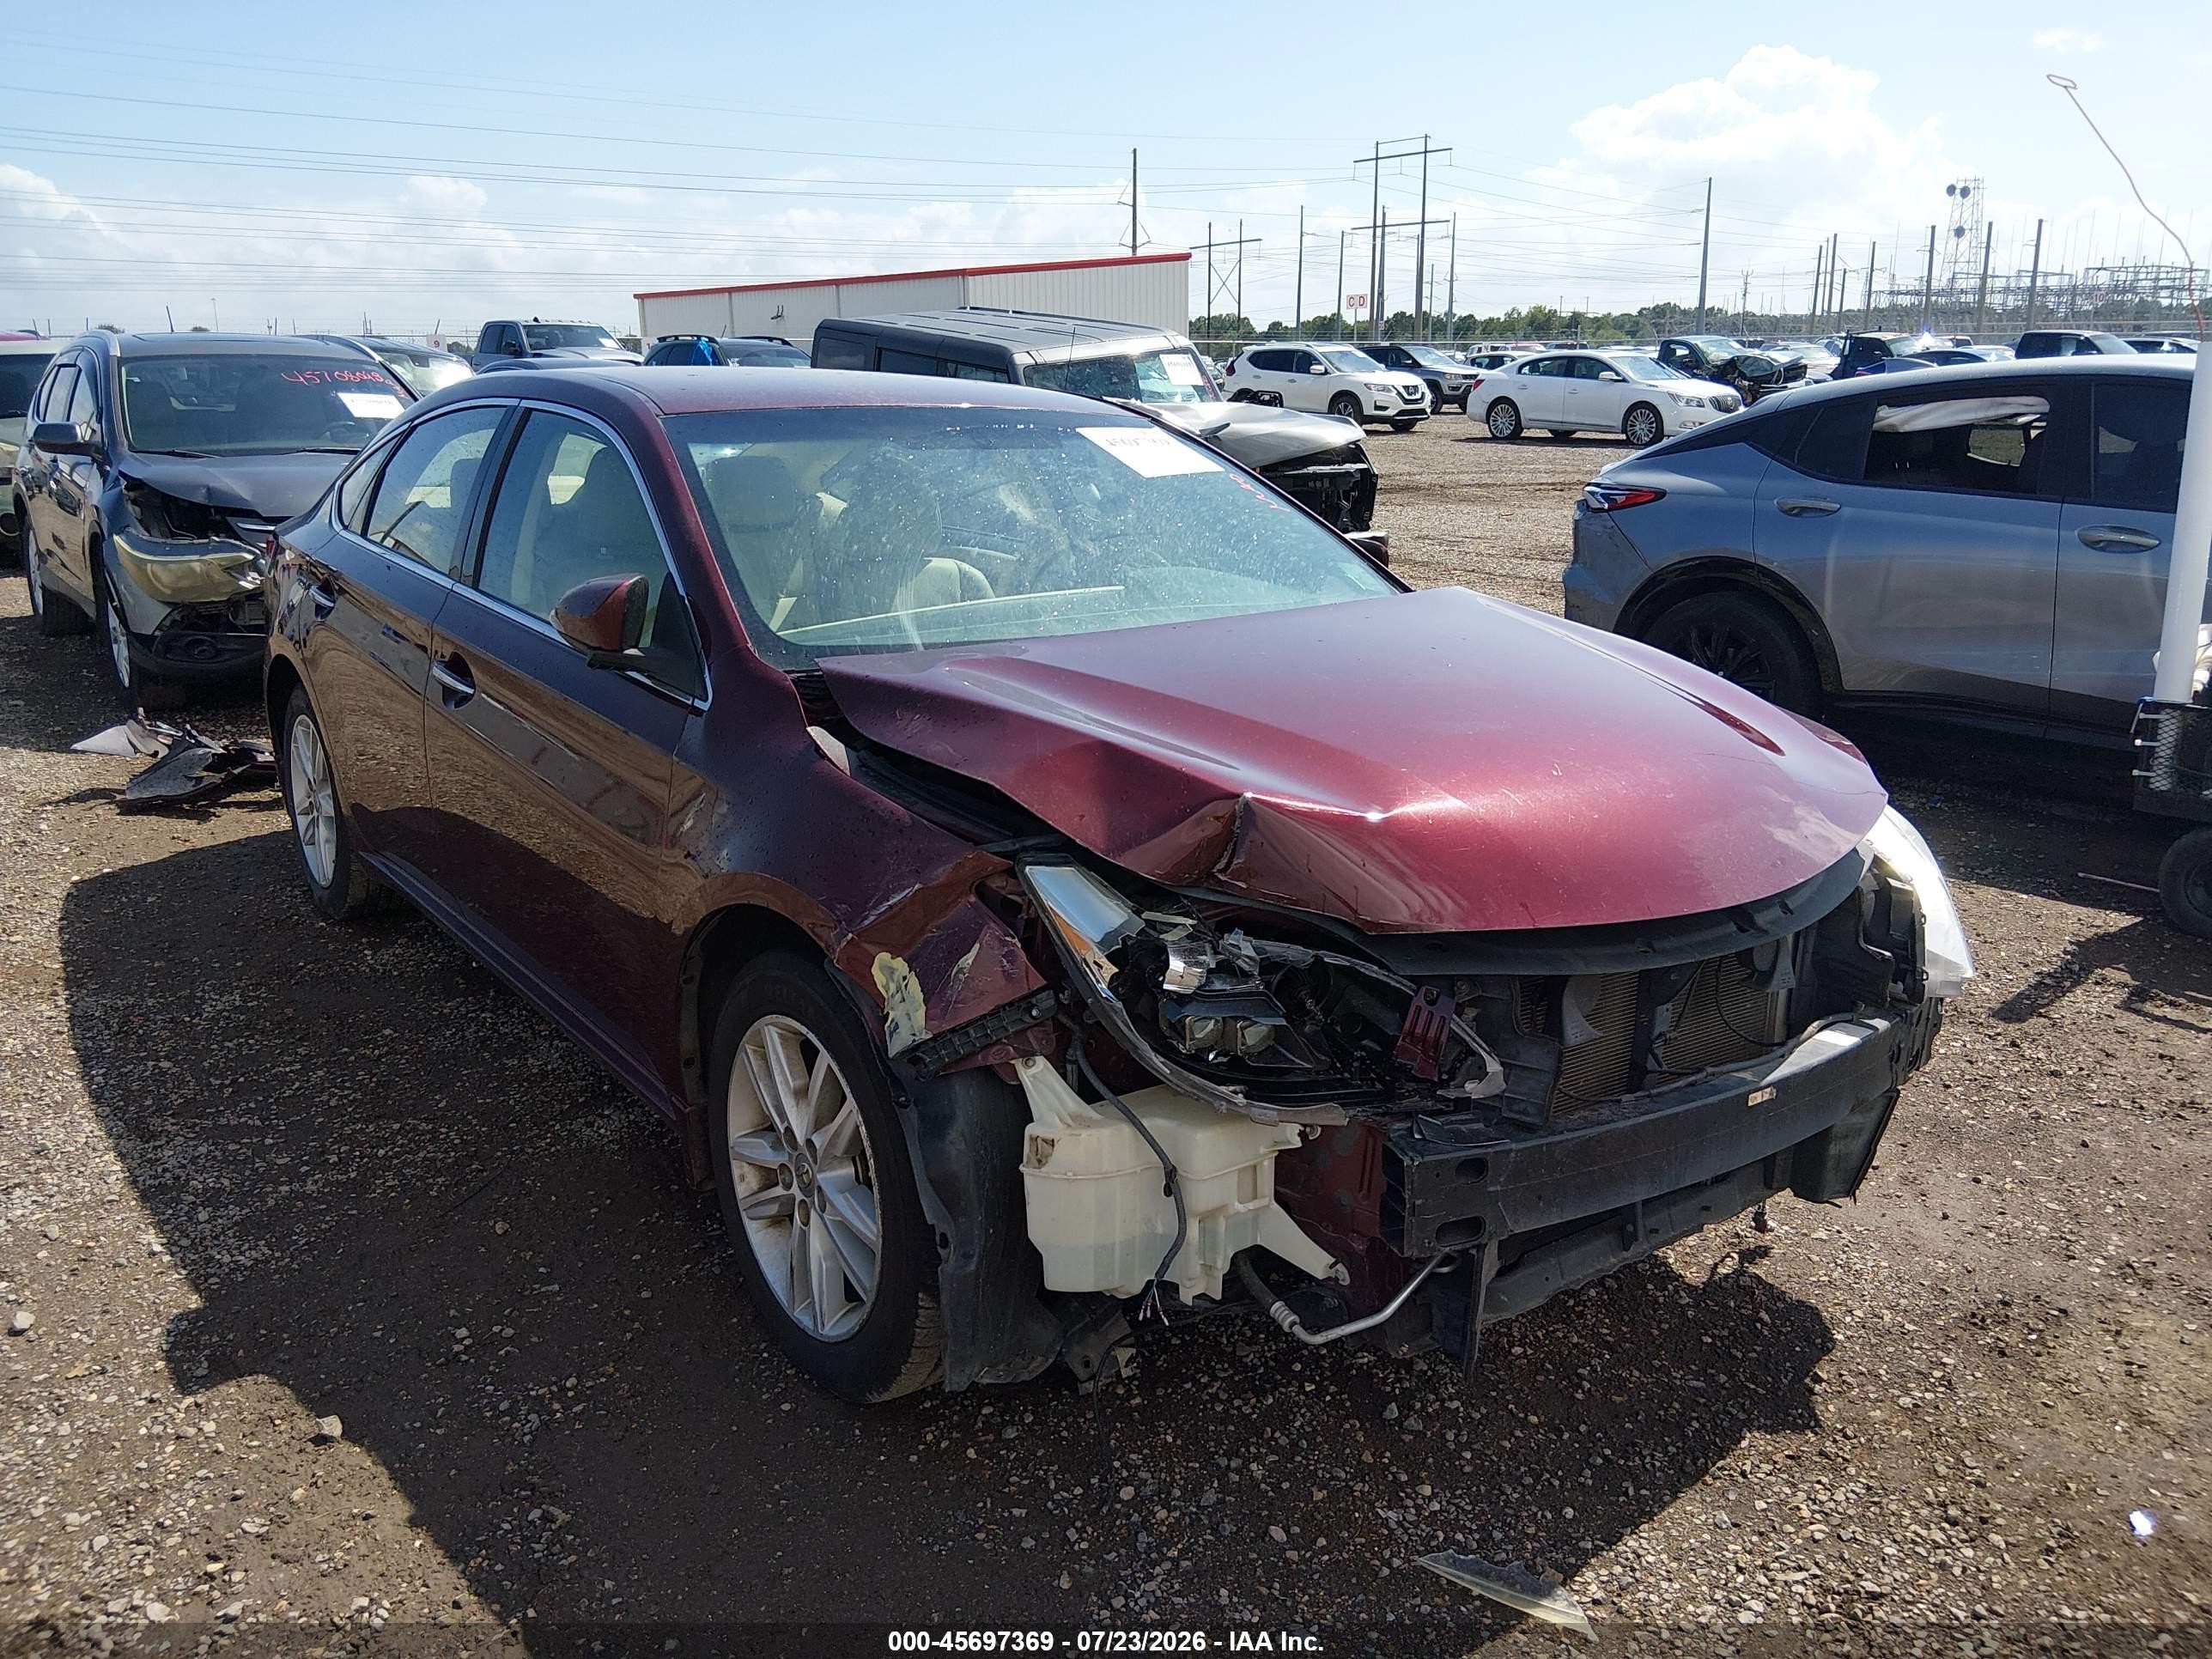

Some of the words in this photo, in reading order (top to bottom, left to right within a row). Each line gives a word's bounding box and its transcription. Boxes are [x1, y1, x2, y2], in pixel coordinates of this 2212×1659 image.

[1348, 296, 1355, 307] C
[1358, 295, 1365, 307] D
[2094, 292, 2105, 302] 10
